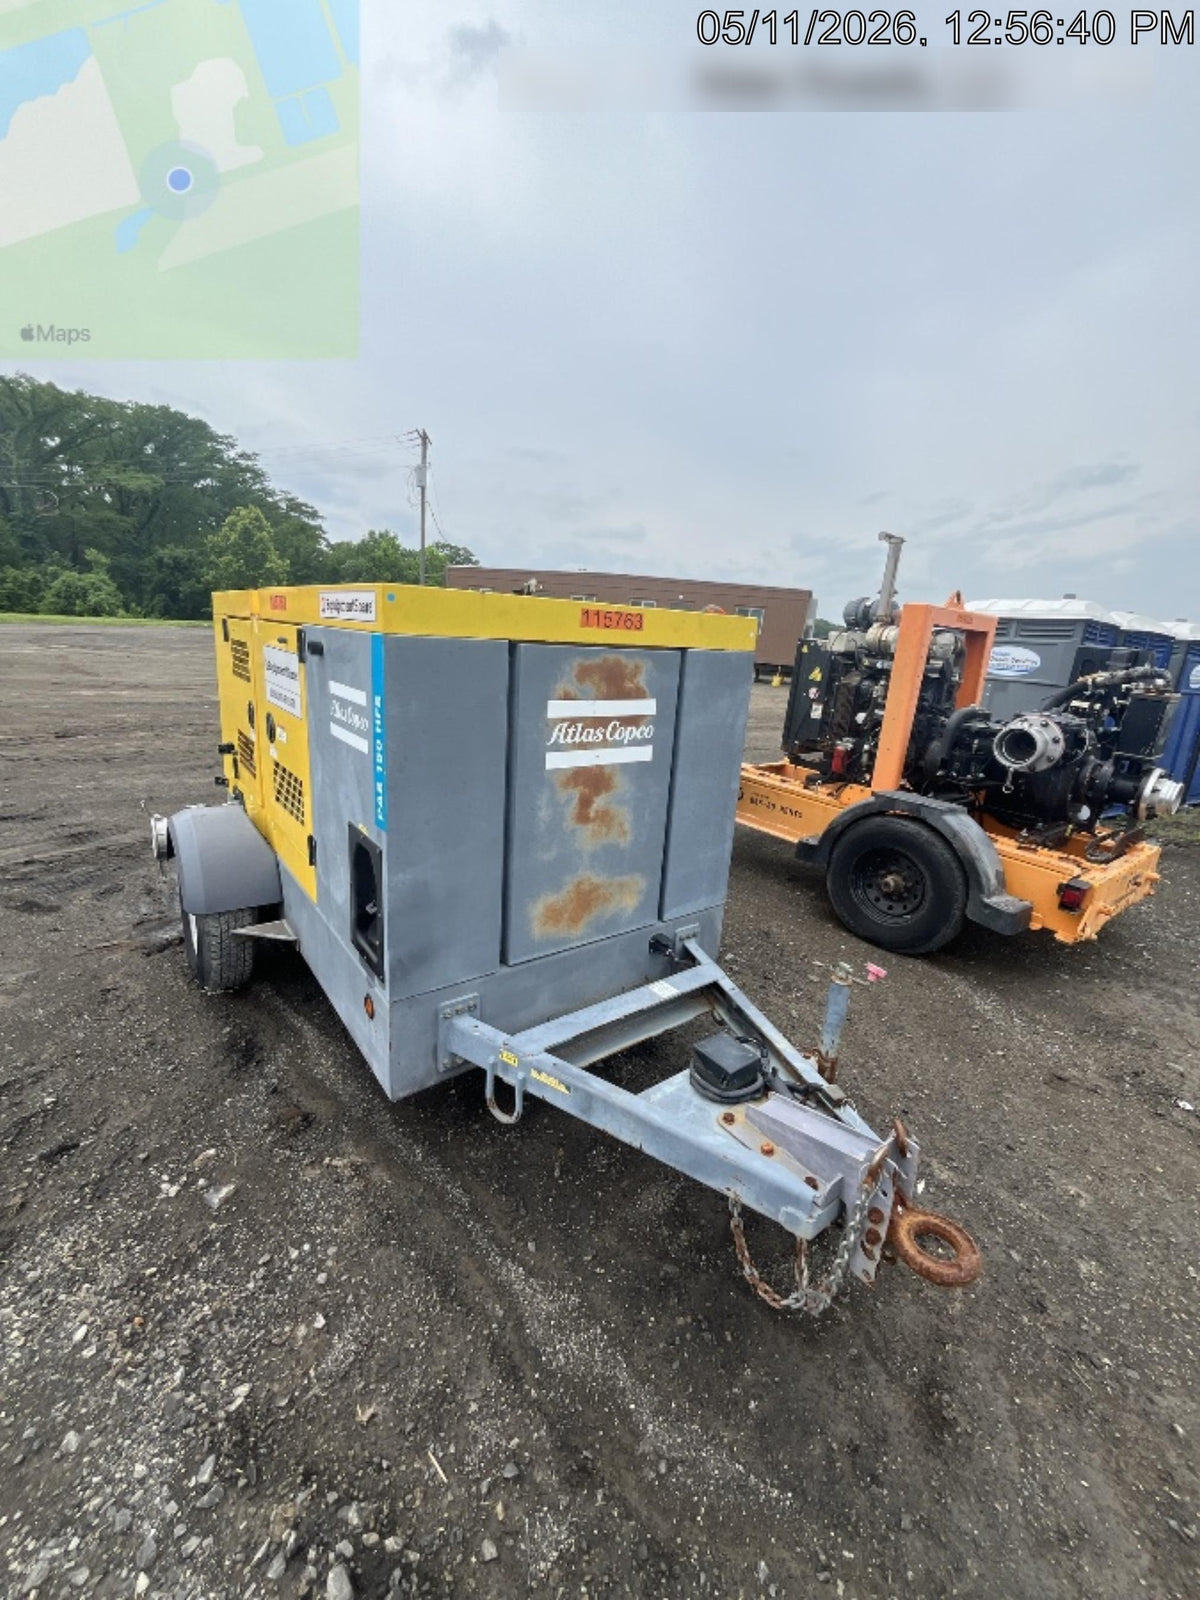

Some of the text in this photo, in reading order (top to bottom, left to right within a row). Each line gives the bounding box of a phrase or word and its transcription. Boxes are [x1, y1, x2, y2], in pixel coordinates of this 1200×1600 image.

[582, 609, 644, 630] 115763
[546, 720, 655, 745] Atlas Copco
